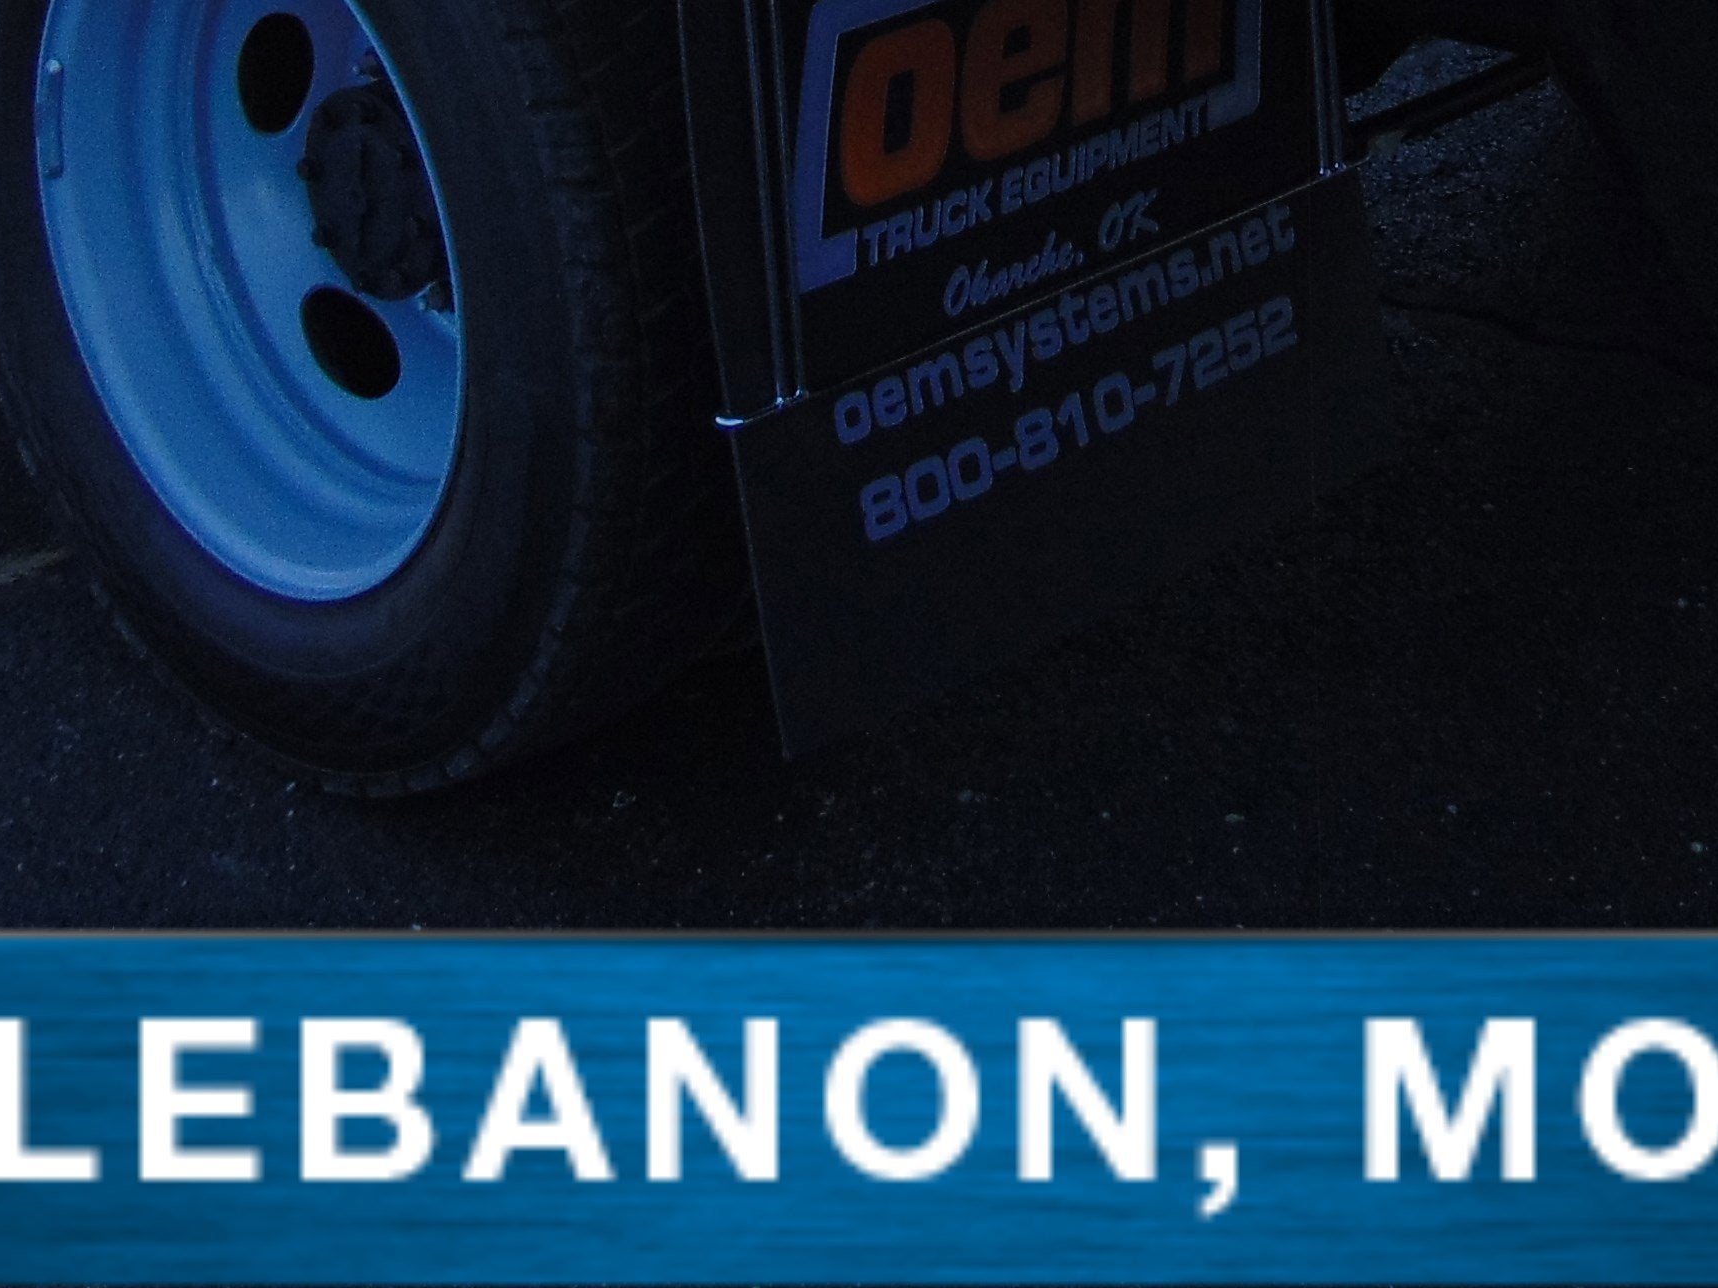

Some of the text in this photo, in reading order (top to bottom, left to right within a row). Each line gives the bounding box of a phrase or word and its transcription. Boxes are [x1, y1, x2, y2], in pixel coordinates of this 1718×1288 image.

[862, 97, 1210, 269] TRUCK EQUIPMENT
[1098, 187, 1161, 248] OK
[833, 201, 1295, 444] oemsystems.net
[859, 295, 1298, 543] 800-810-7252
